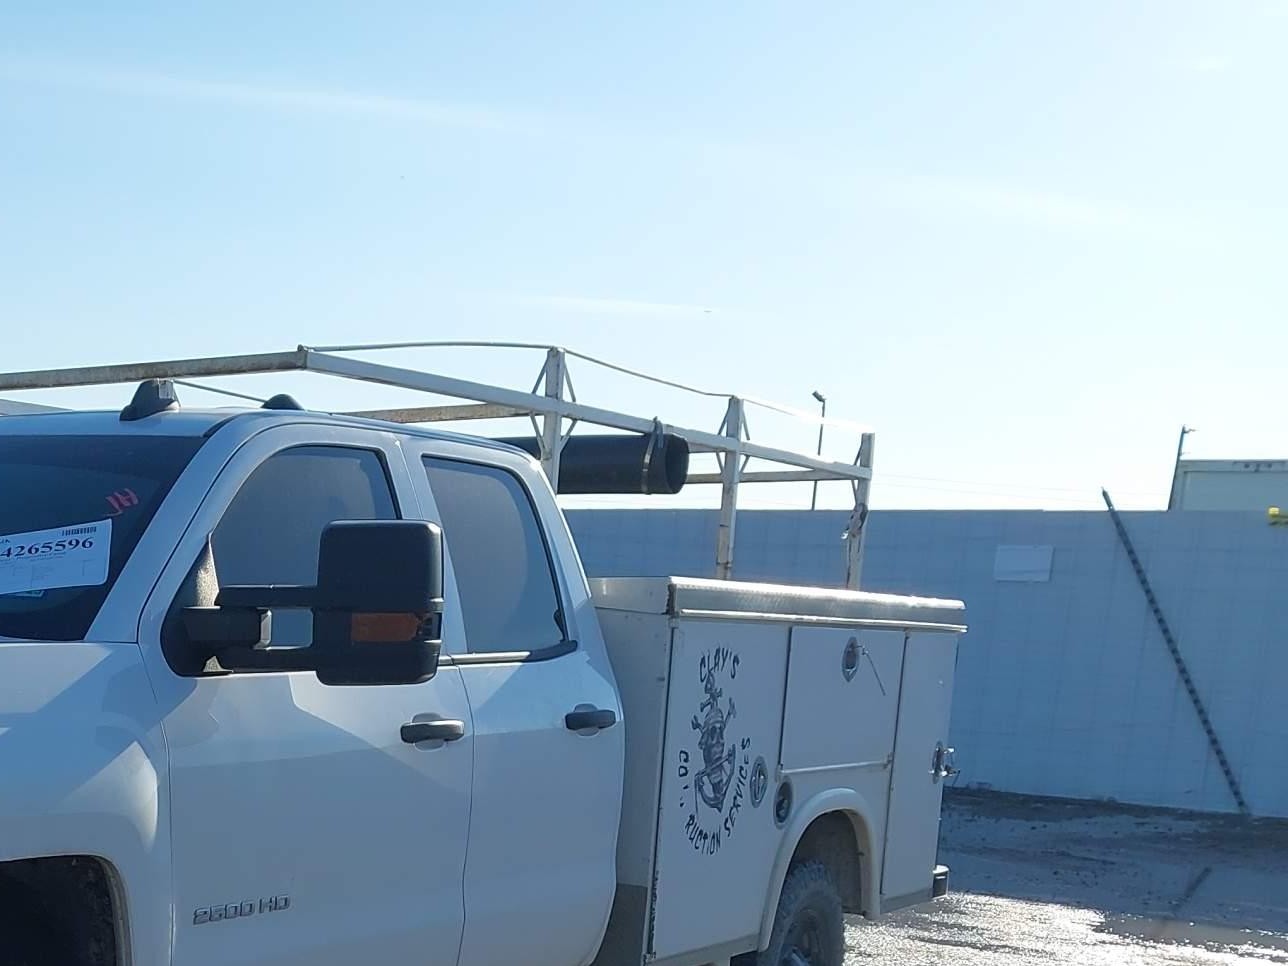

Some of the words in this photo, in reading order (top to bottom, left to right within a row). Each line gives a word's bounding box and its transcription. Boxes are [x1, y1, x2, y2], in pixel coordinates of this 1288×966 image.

[699, 646, 740, 683] CLAY'S
[192, 900, 256, 926] 2500
[258, 895, 291, 915] HD
